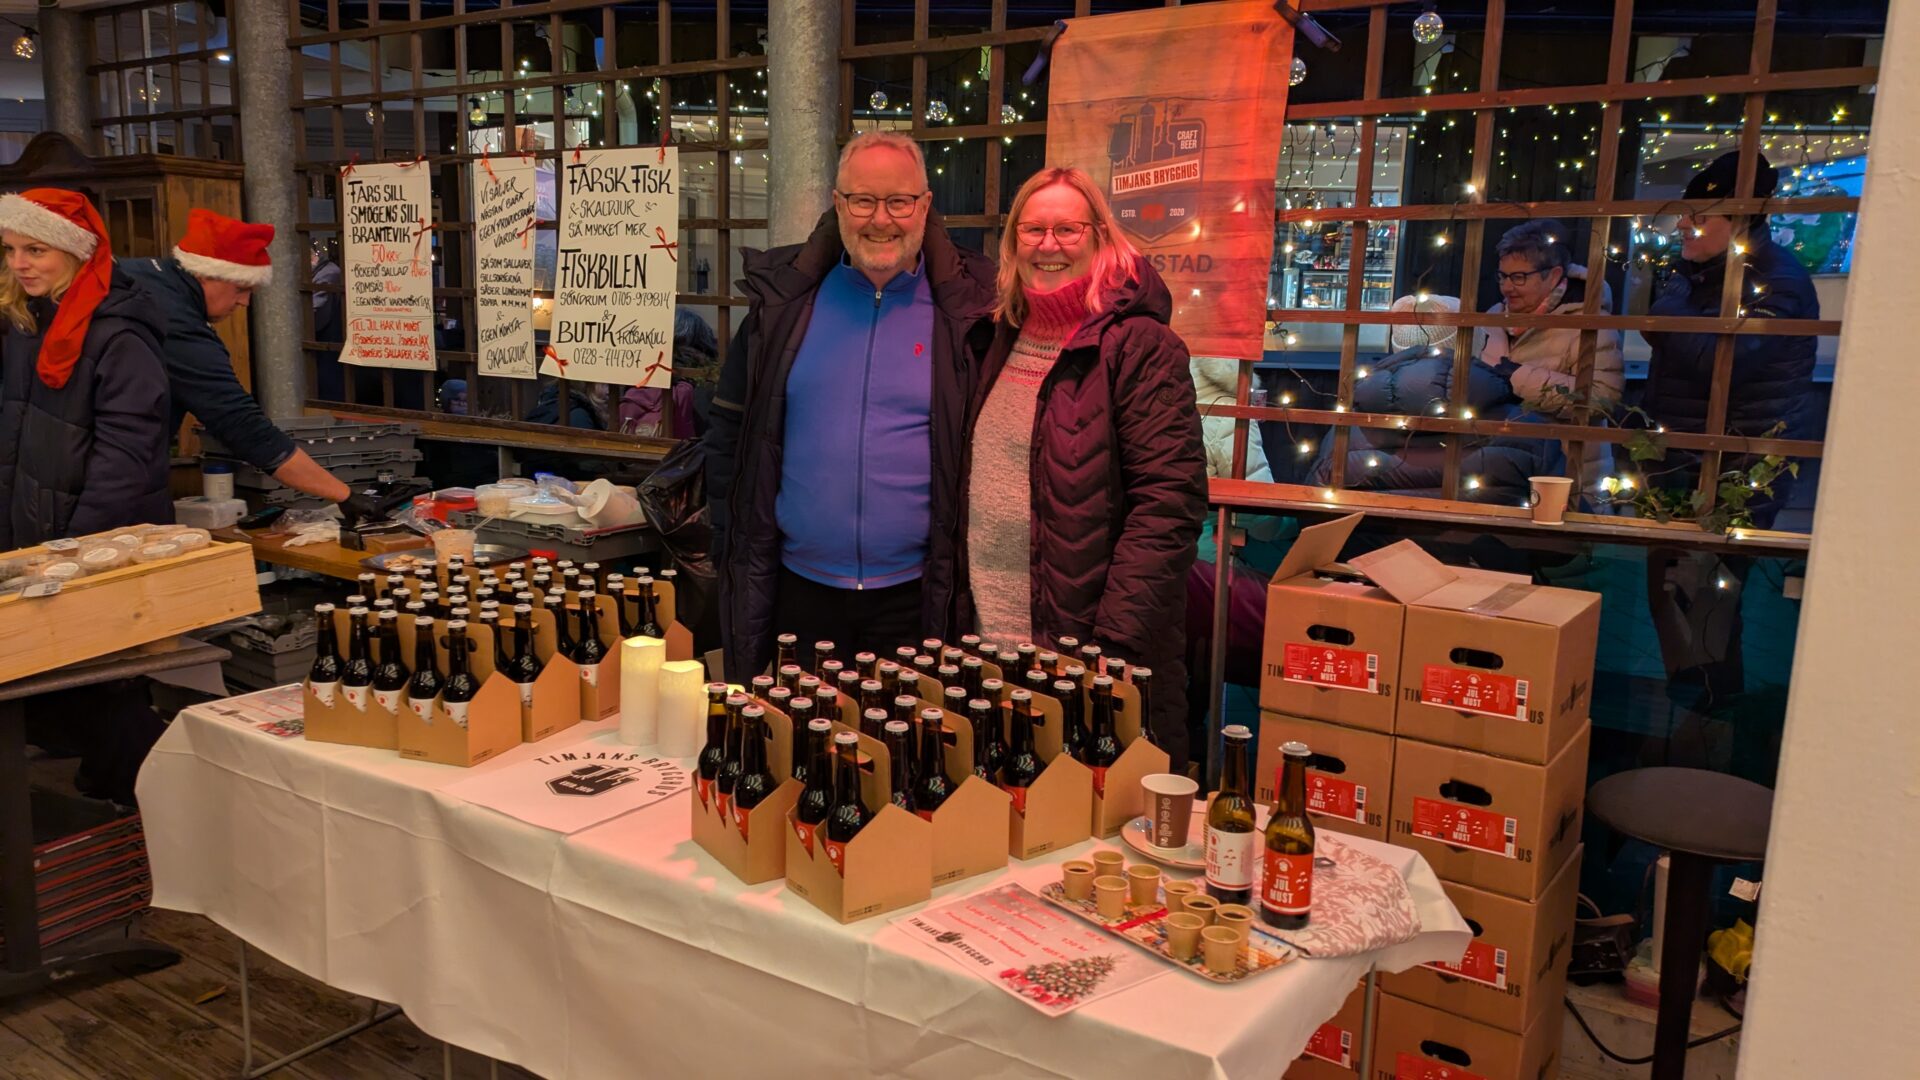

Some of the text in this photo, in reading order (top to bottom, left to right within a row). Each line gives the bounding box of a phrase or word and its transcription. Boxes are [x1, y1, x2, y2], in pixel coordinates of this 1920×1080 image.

[1177, 130, 1198, 141] CRAFT
[1180, 139, 1197, 149] BEER
[630, 165, 674, 194] FISK
[1115, 163, 1198, 191] TIMJANS BRYGGHUS
[384, 184, 407, 202] SILL
[401, 204, 420, 223] SILL
[580, 199, 640, 218] SKALDJUR
[1169, 208, 1185, 217] 2020
[352, 226, 411, 244] BRANTEVIK
[569, 220, 650, 238] SÅ MYCKET MER
[381, 266, 408, 276] SALLAD
[560, 248, 647, 289] FISKBILEN
[1150, 254, 1212, 273] STAD
[560, 290, 607, 306] SÖNDRUM
[556, 315, 616, 347] BUTIK
[487, 342, 531, 370] SKALDJUR
[1462, 696, 1482, 707] MUST
[1466, 688, 1479, 699] JUL
[534, 751, 685, 797] TIMJANS BRYGGHUS
[1452, 831, 1470, 843] MUST
[1456, 823, 1468, 833] JUL
[1273, 878, 1290, 891] JUL
[1269, 888, 1294, 904] MUST
